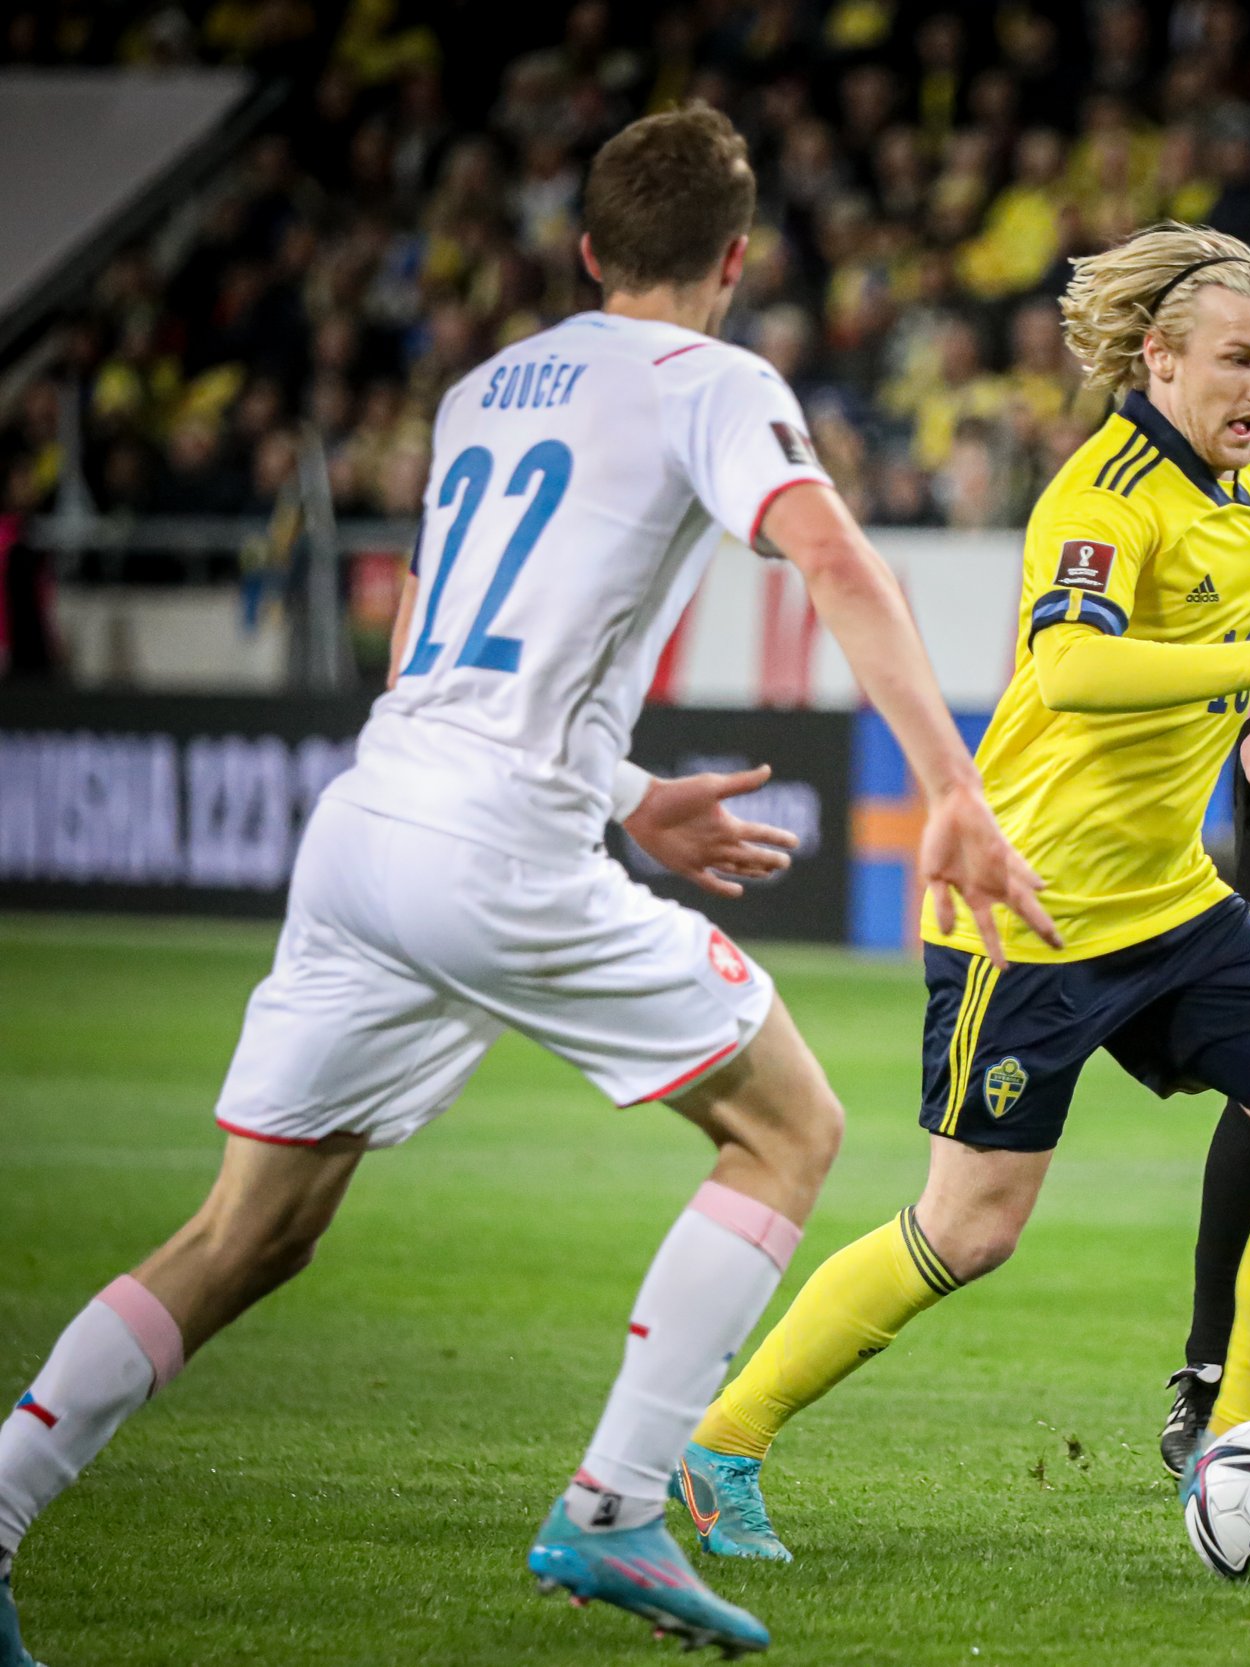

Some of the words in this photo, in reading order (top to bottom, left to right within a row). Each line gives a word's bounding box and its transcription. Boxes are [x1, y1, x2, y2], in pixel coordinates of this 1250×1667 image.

[481, 355, 590, 410] SOUČEK
[399, 439, 574, 677] 22
[1185, 593, 1220, 603] adidas
